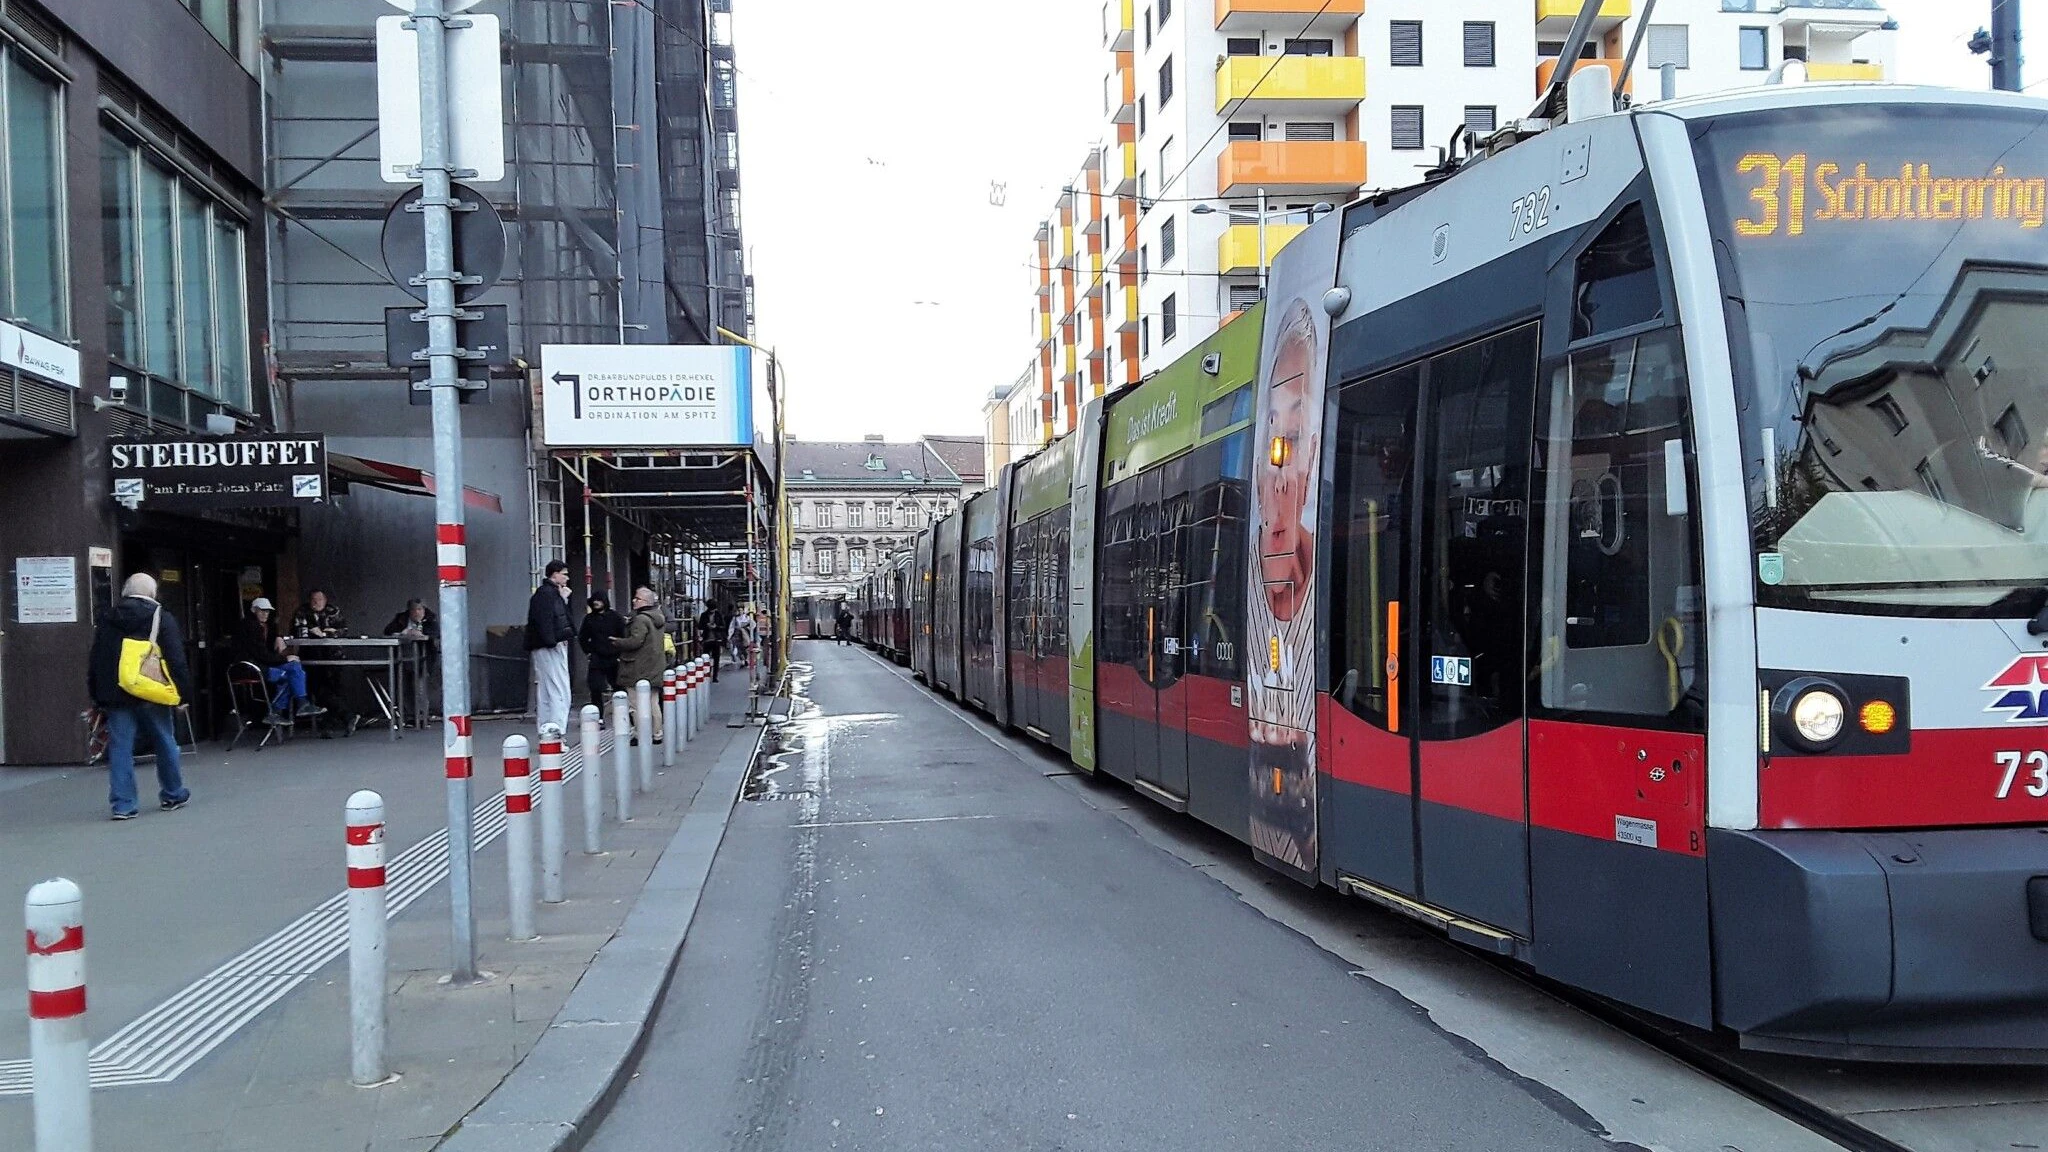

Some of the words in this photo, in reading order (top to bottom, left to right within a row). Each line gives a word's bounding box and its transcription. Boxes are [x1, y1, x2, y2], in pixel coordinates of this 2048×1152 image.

[1735, 152, 1806, 236] 31
[1813, 162, 2047, 229] Schottenring
[1509, 184, 1551, 242] 732
[588, 411, 658, 420] ORDINATION
[664, 411, 679, 419] AM
[684, 411, 717, 420] SPITZ
[112, 441, 319, 469] STEHBUFFET
[1616, 817, 1655, 832] Wagenmasse
[1690, 830, 1699, 851] B
